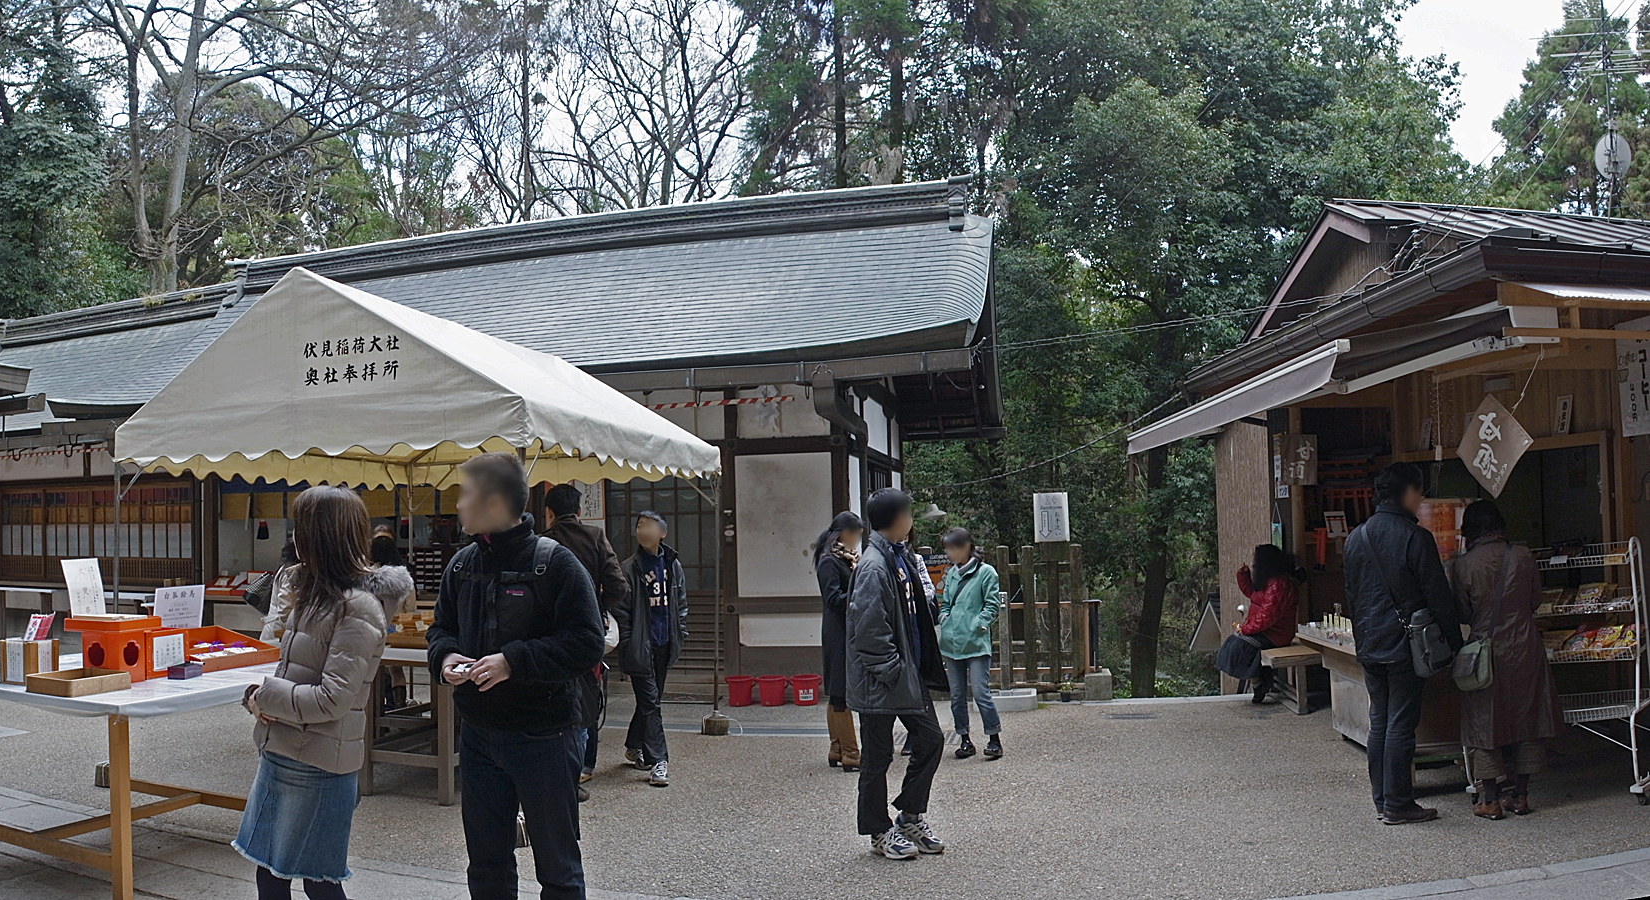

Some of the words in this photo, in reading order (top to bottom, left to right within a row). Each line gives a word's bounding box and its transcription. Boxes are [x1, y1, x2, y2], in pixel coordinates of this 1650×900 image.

[303, 335, 400, 359] 伏見稲荷大社
[304, 360, 400, 386] 奥社奉拝所
[1638, 349, 1650, 411] コーヒー
[1288, 440, 1315, 480] 甘酒
[1054, 511, 1062, 536] お手洗い
